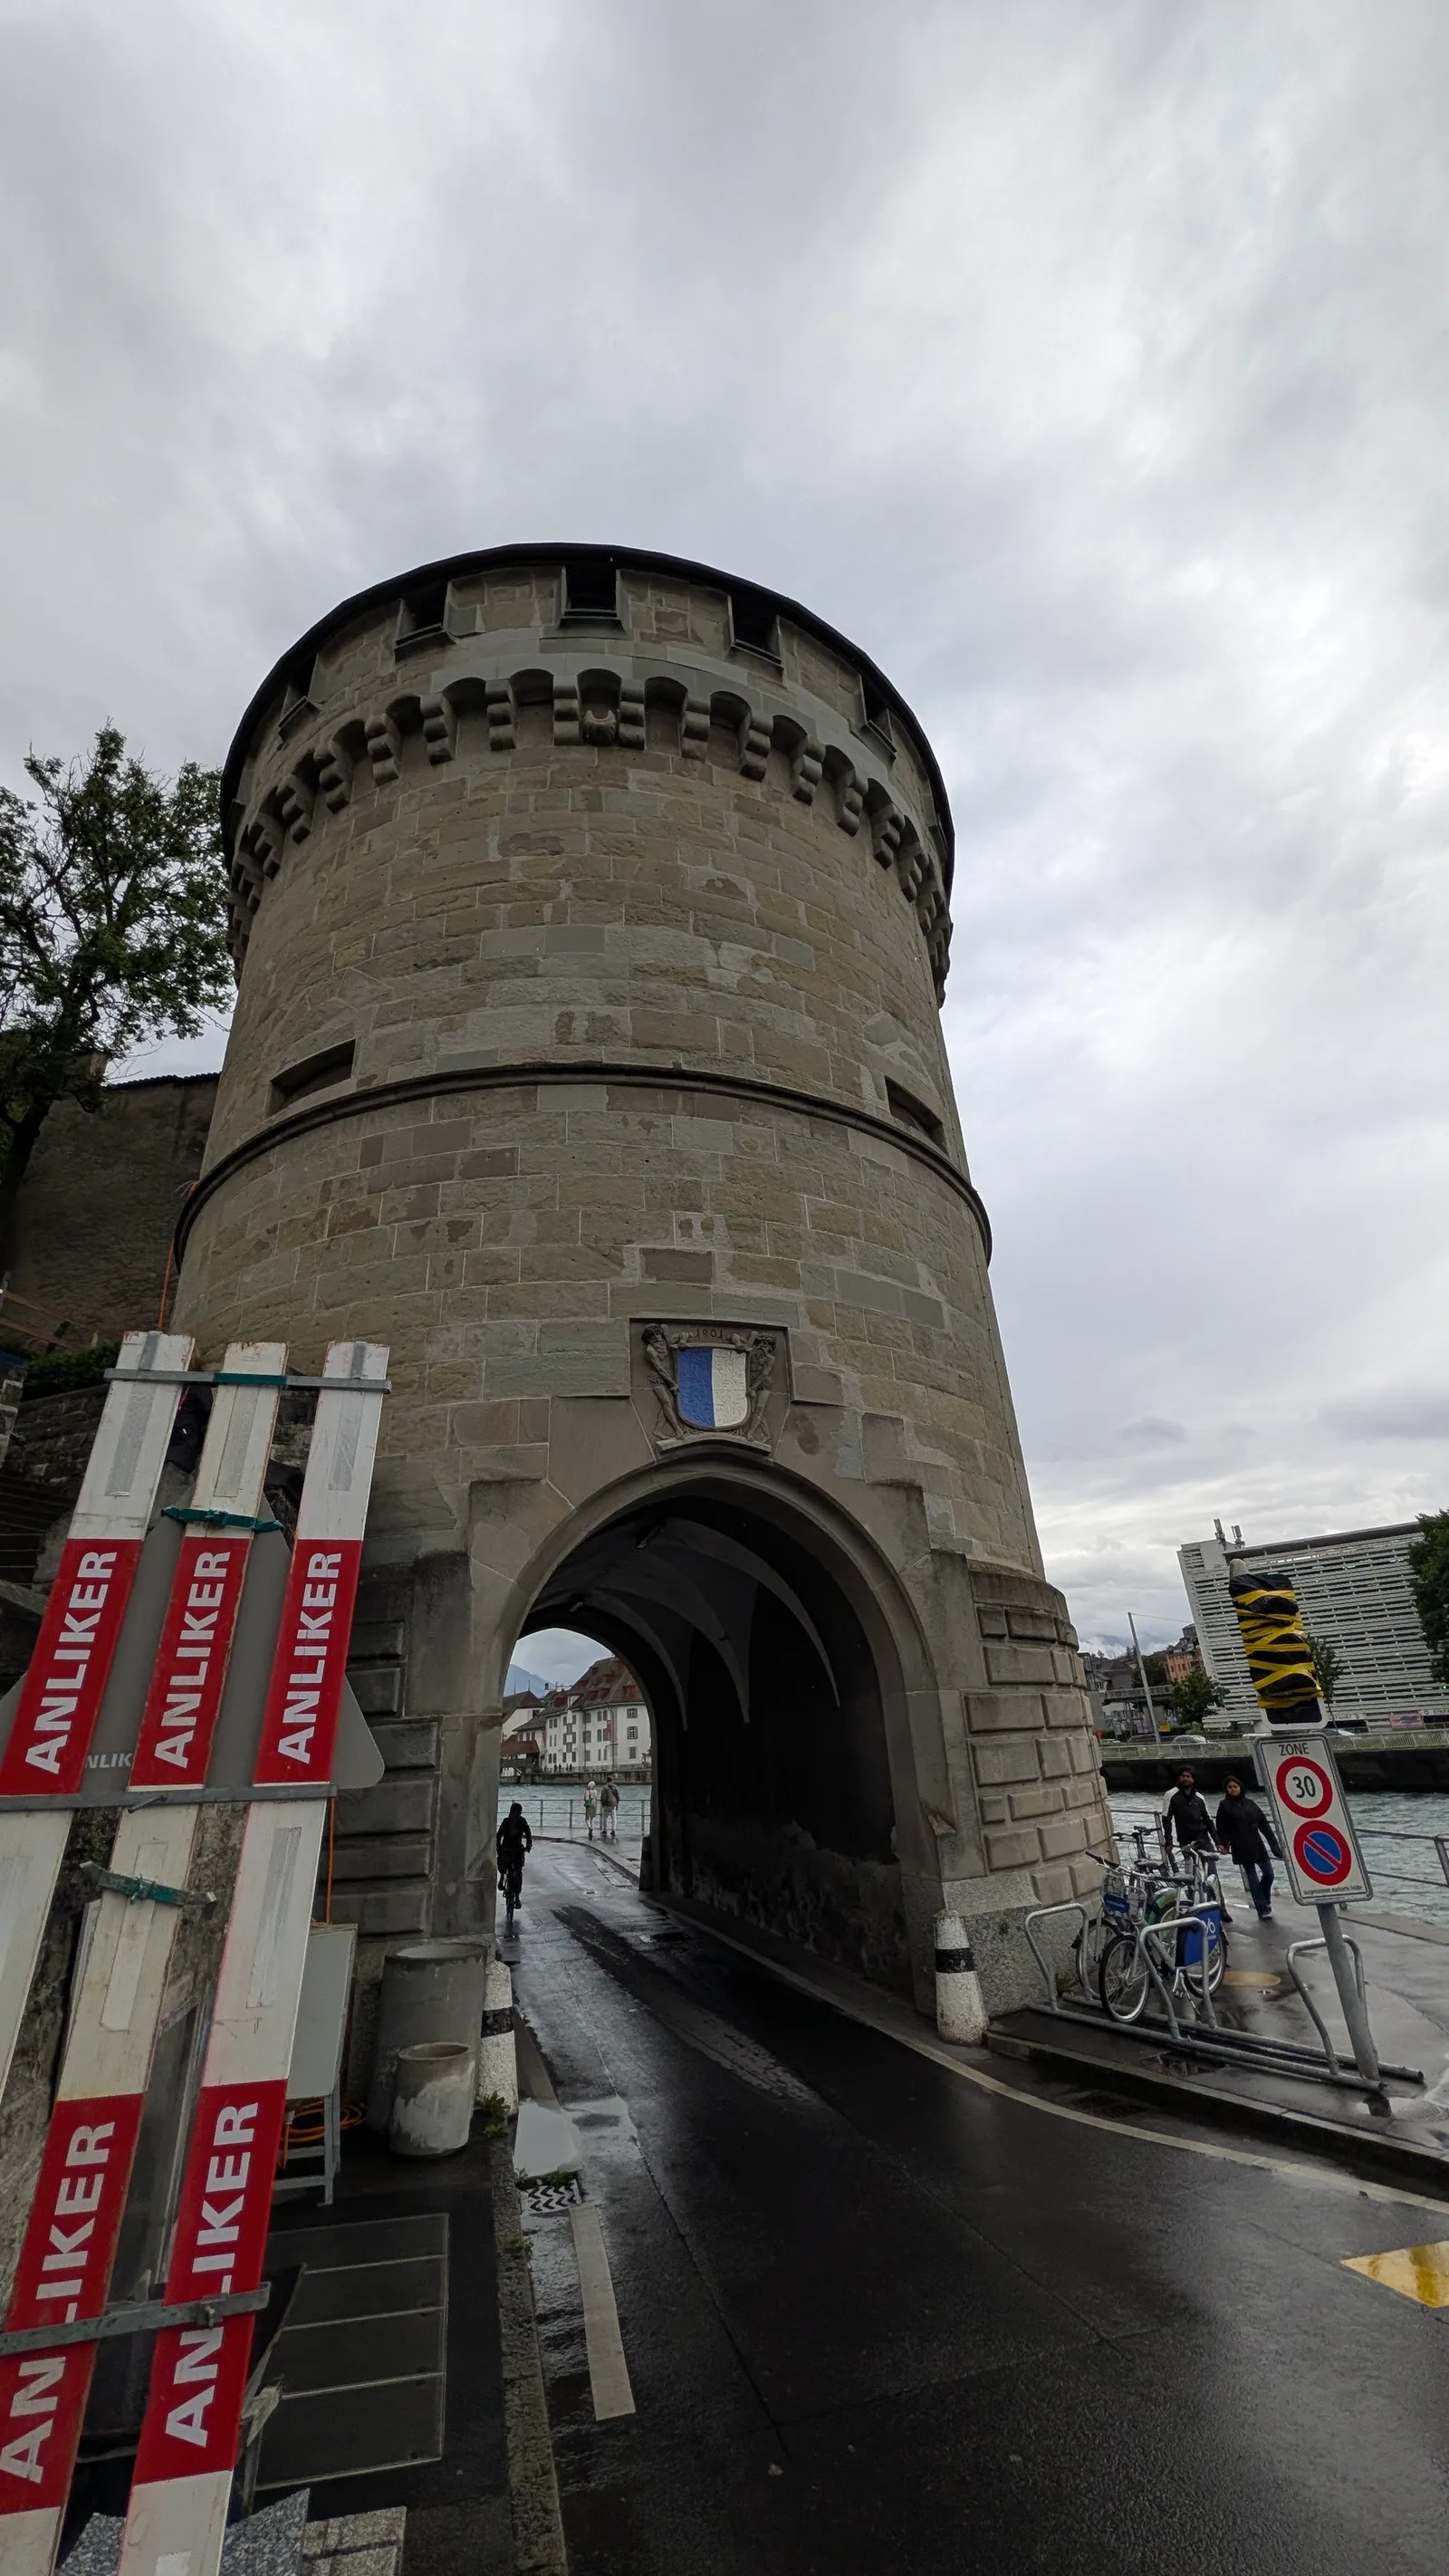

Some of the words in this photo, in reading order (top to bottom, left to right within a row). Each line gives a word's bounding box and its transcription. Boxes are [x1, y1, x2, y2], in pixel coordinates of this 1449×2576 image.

[25, 1552, 117, 1773] ANLIKER
[85, 1754, 133, 1769] NLIK
[155, 1552, 230, 1768] ANLIKER
[278, 1553, 341, 1764] ANLIKER
[1278, 1743, 1310, 1756] ZONE
[1292, 1775, 1316, 1798] 30
[0, 2121, 115, 2484] ANIKER
[166, 2102, 259, 2447] ANIKER
